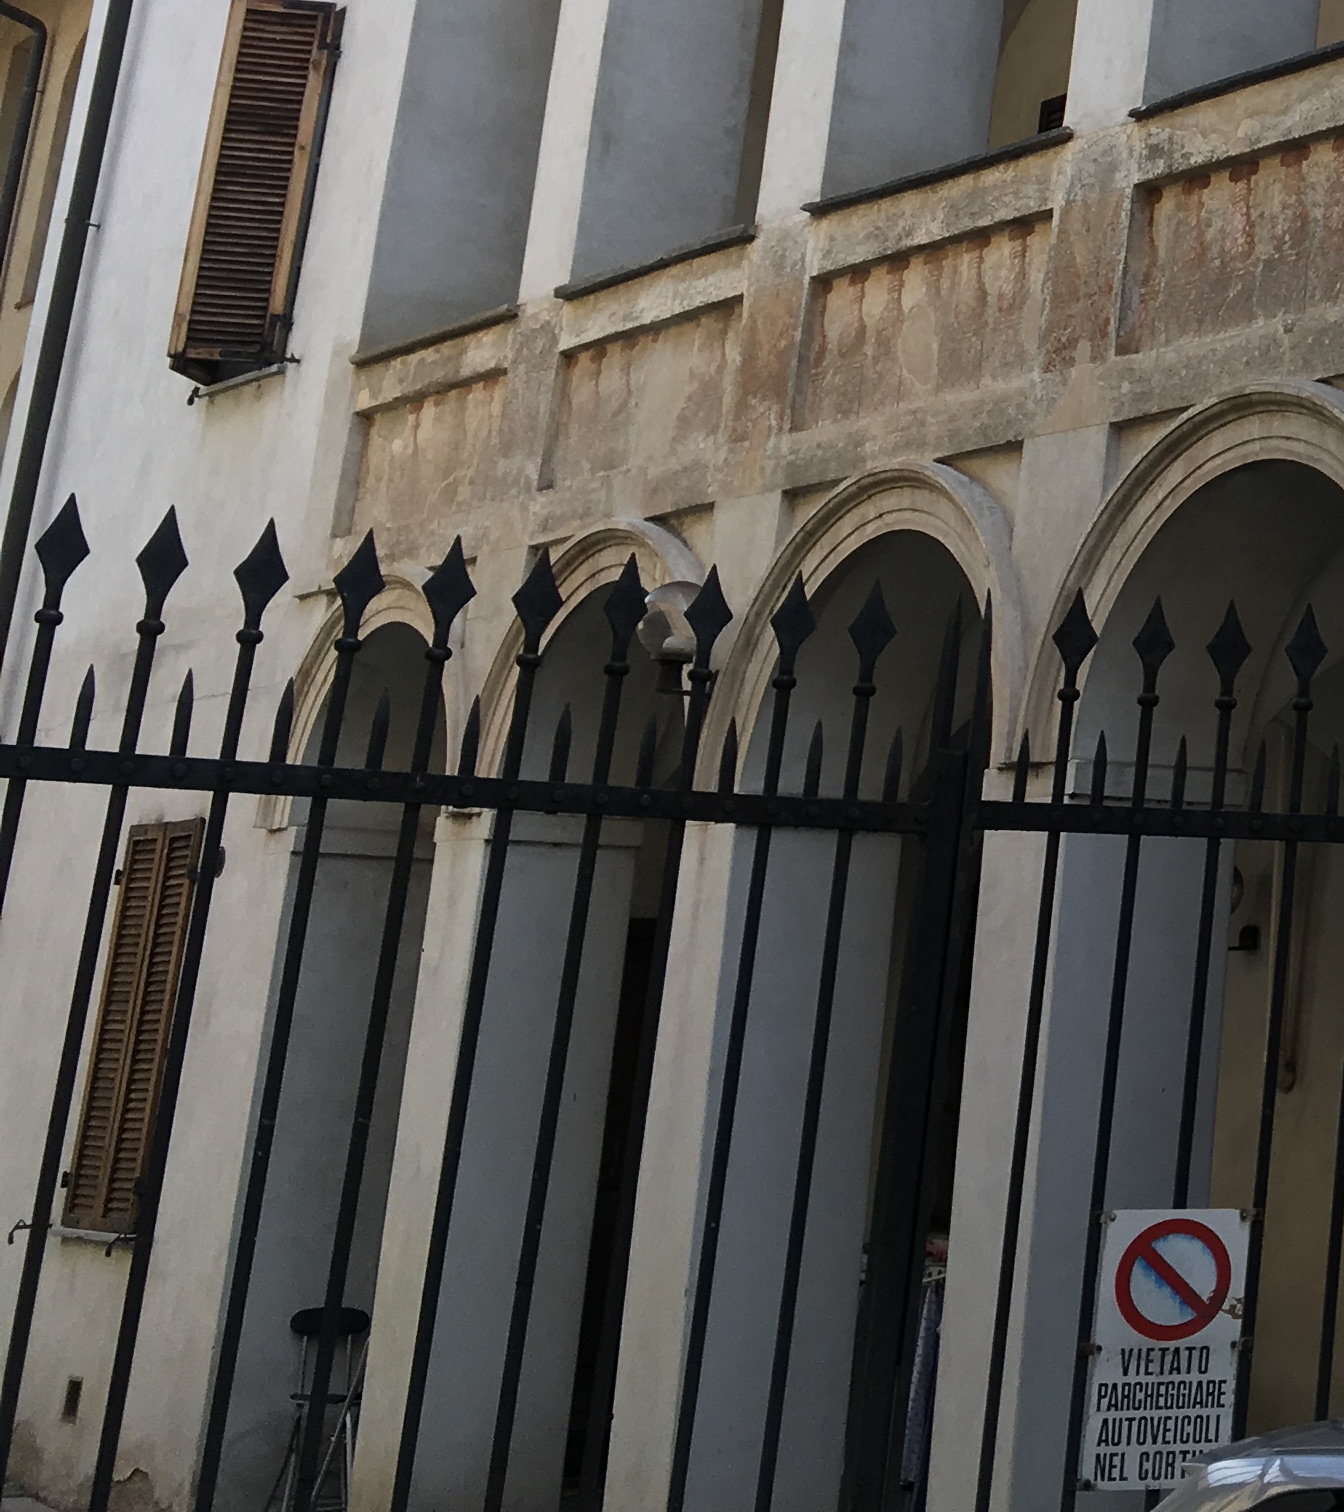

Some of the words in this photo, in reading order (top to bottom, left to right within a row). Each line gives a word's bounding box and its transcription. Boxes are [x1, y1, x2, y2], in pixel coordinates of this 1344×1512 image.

[1120, 1345, 1210, 1377] VIETATO
[1095, 1379, 1227, 1413] PARCHEGGIARE
[1096, 1414, 1221, 1448] AUTOVEICOLI
[1093, 1452, 1128, 1482] NEL
[1138, 1449, 1204, 1482] CORT
